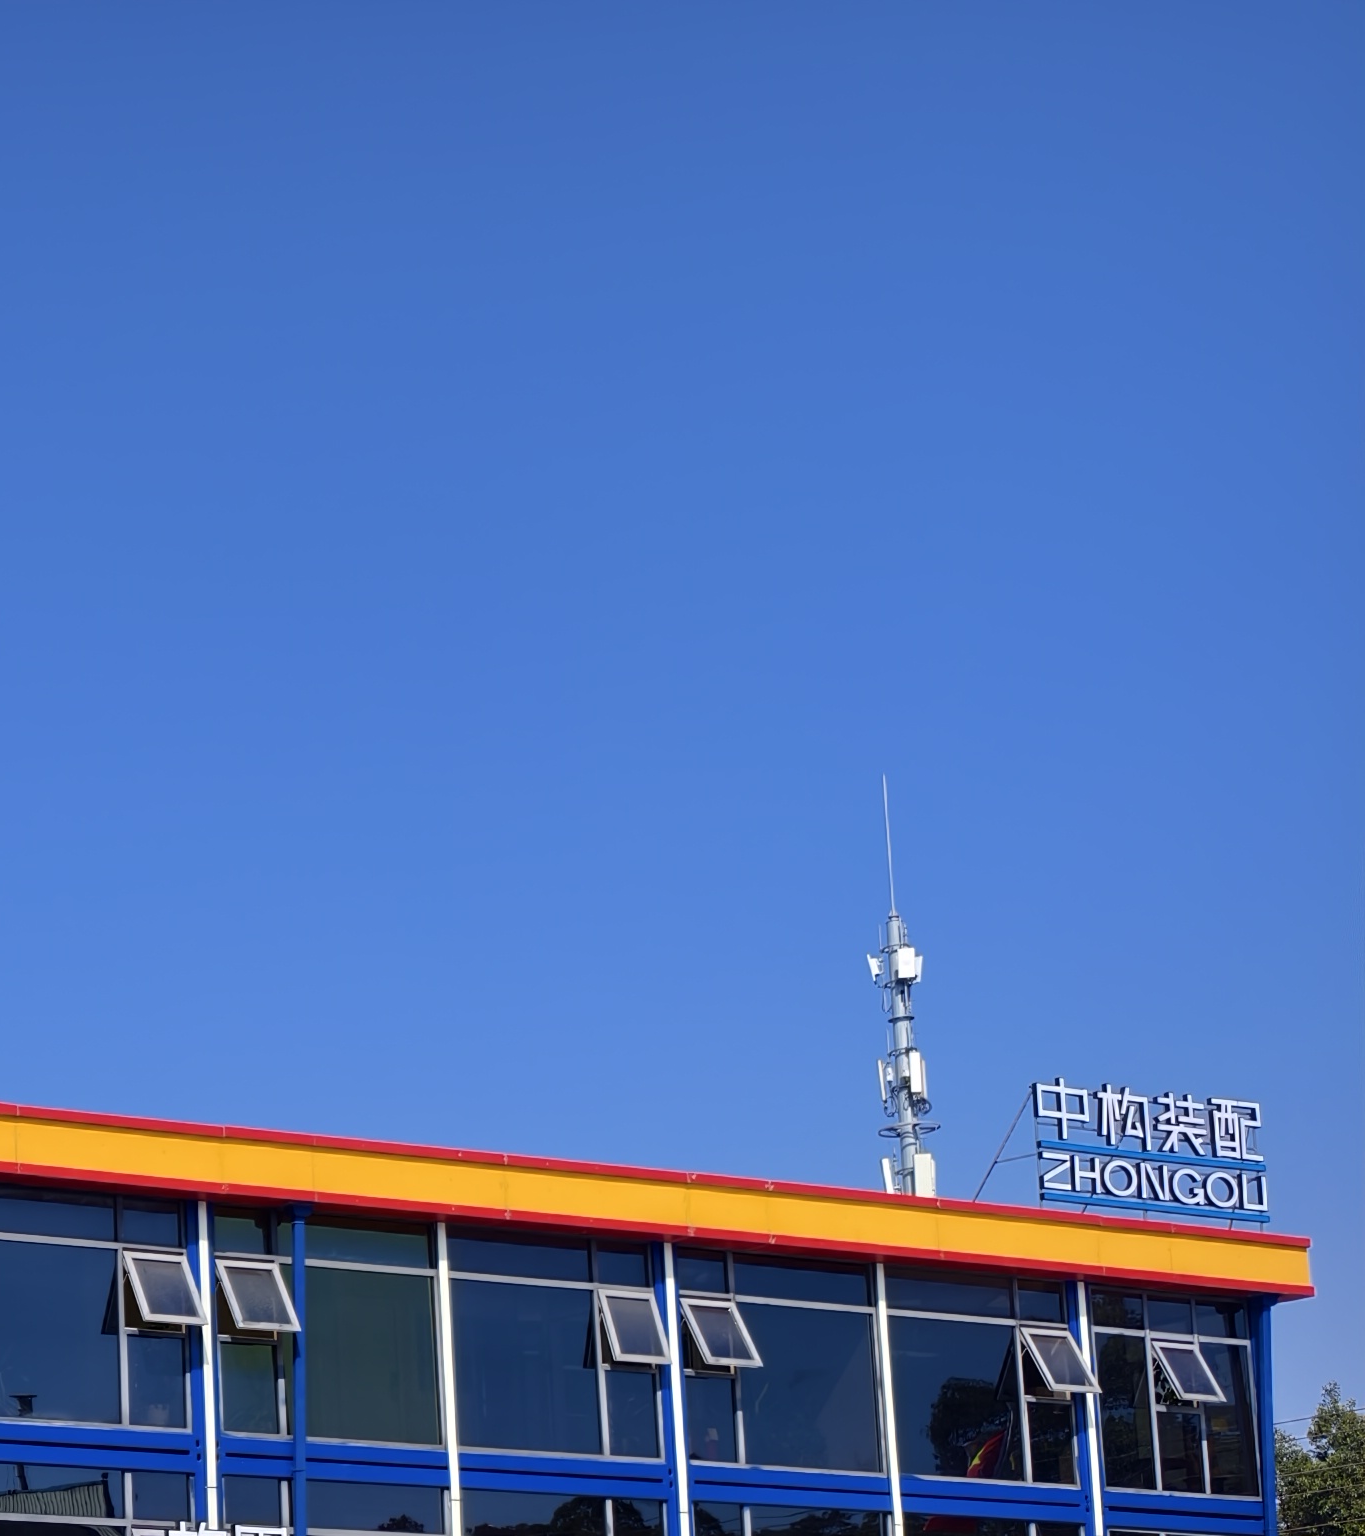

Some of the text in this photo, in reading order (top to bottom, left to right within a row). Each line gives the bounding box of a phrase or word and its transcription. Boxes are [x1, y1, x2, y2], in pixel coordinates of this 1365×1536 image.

[1032, 1077, 1264, 1162] 中构装配
[1039, 1151, 1269, 1212] ZHONGOU
